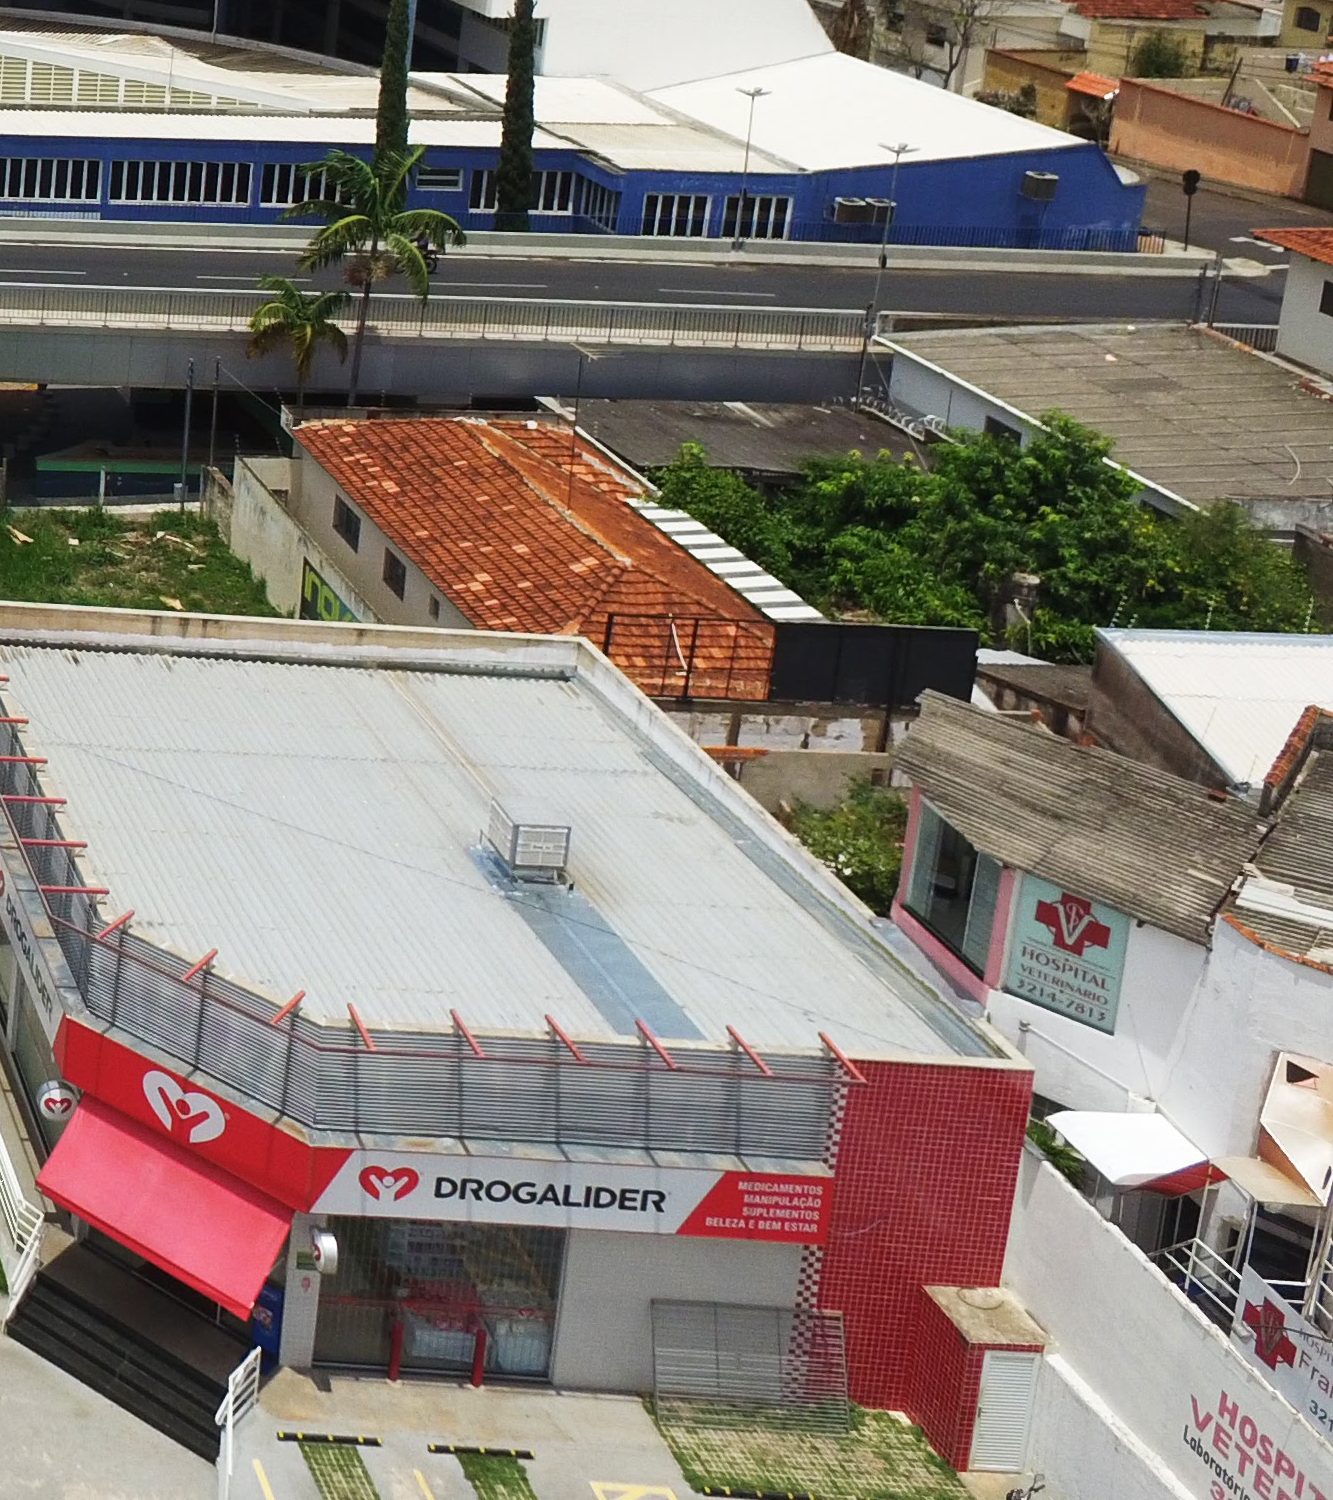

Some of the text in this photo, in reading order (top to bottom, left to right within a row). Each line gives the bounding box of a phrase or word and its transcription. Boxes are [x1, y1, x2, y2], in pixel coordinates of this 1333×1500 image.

[5, 894, 53, 1023] DROGALIDER
[1020, 946, 1108, 991] HOSPITAL
[1016, 978, 1107, 1022] 3214-7813
[434, 1176, 667, 1213] DROGALIDER
[738, 1181, 823, 1195] MEDICAMENTOS
[744, 1194, 822, 1209] MANIPULAÇÃO
[705, 1216, 818, 1233] BELEZA E BEM ESTAR
[742, 1206, 820, 1221] SUPLEMENTOS
